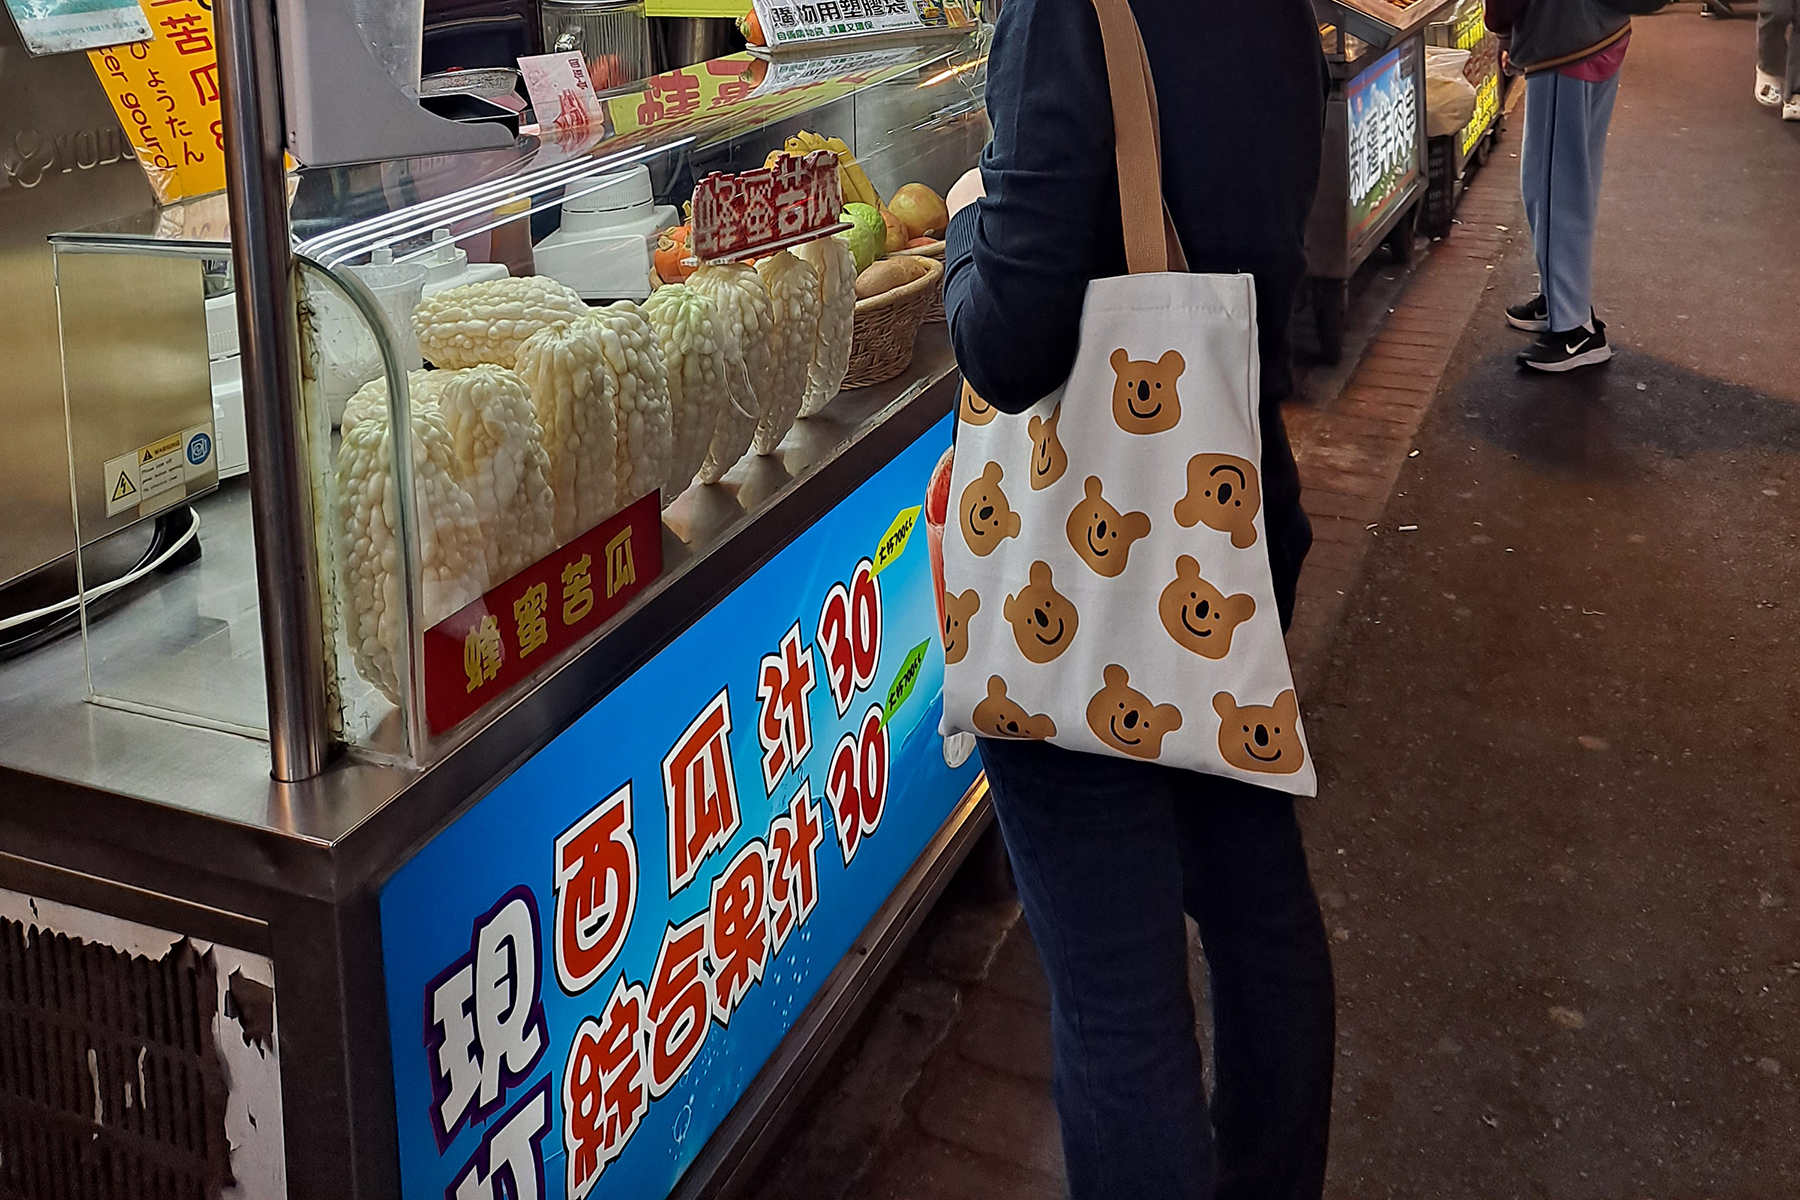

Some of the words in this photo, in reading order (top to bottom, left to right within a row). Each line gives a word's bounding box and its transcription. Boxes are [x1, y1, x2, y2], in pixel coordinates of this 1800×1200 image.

[120, 92, 178, 172] gourd
[464, 525, 636, 693] 蜂蜜苦瓜
[554, 619, 817, 996] 西瓜汁
[818, 558, 881, 714] 30
[562, 784, 822, 1200] 綜合果汁
[826, 705, 890, 868] 30
